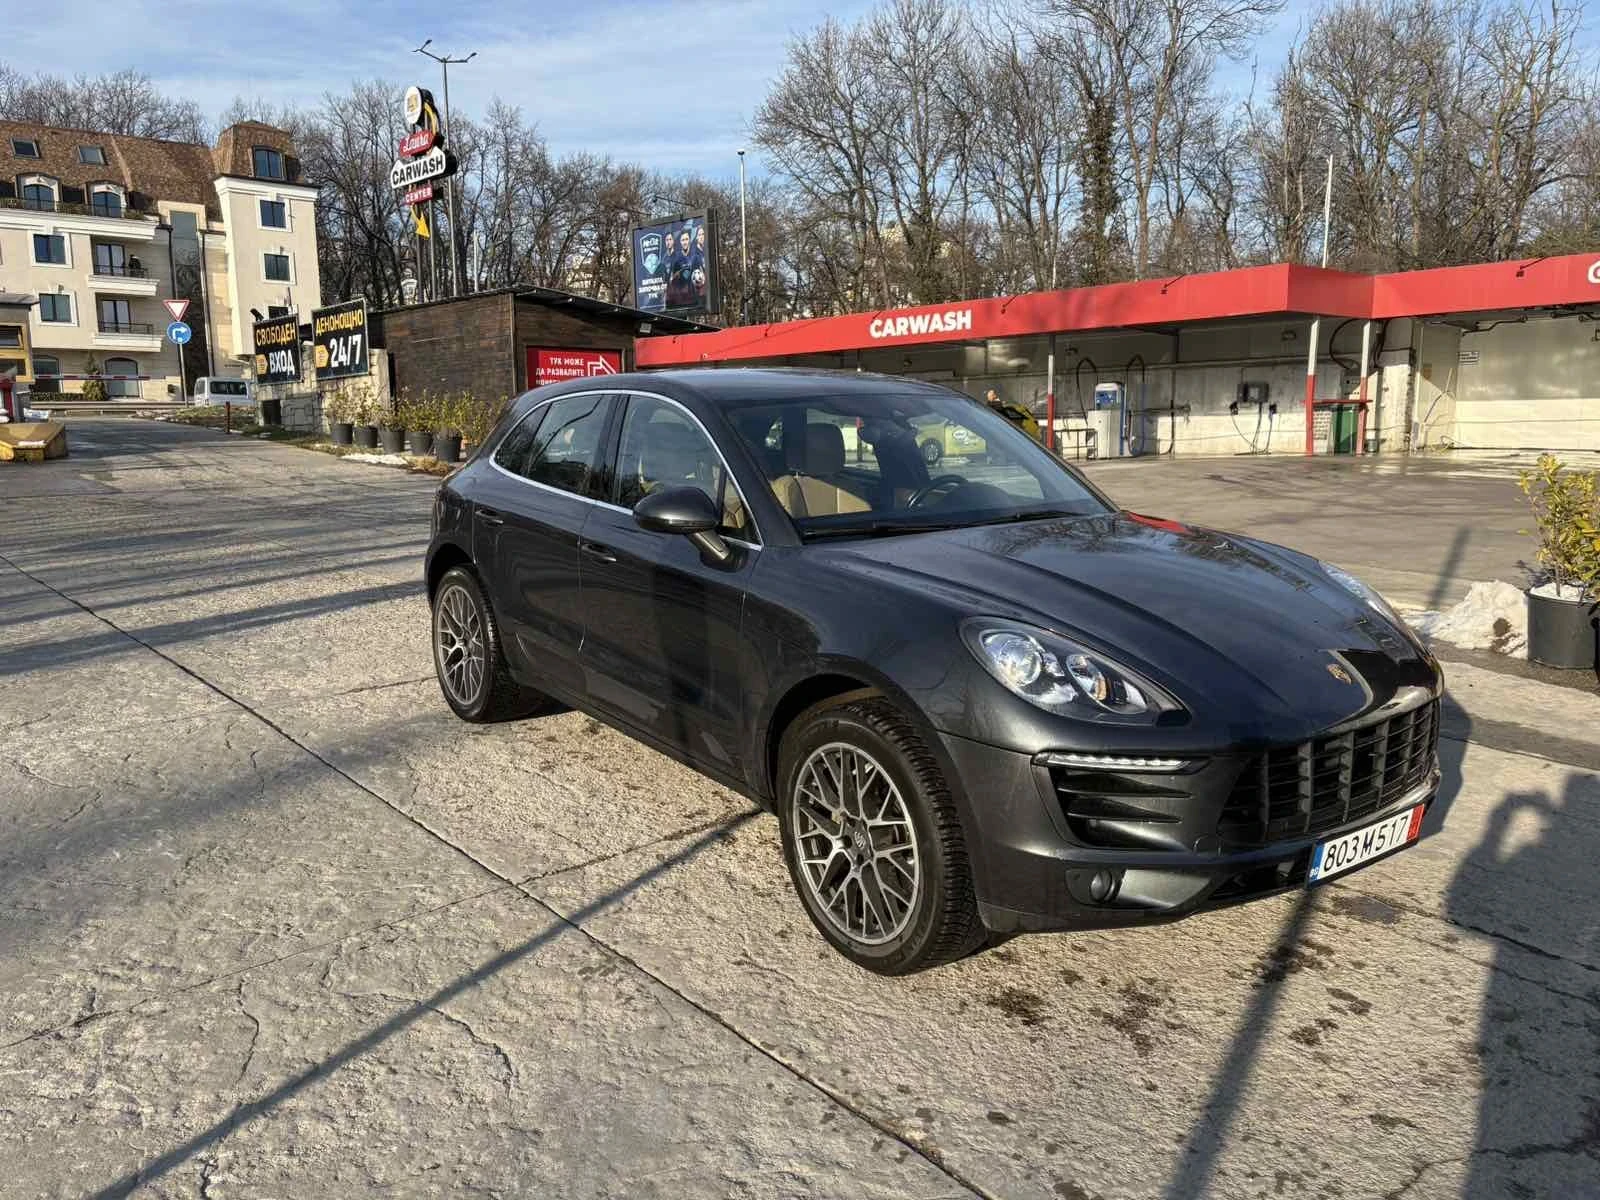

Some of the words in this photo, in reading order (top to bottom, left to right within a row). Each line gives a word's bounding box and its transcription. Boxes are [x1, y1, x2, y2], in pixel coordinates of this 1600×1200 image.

[392, 154, 443, 185] CARWASH
[405, 187, 432, 202] CENTER
[256, 323, 296, 345] СВОБОДЕН
[316, 310, 363, 337] ДЕНОНОЩНО
[869, 309, 972, 338] CARWASH
[268, 349, 295, 375] ВХОД
[329, 334, 362, 368] 24/7
[549, 357, 561, 365] ТУК
[536, 368, 545, 376] ДА
[1324, 815, 1408, 872] 803M517
